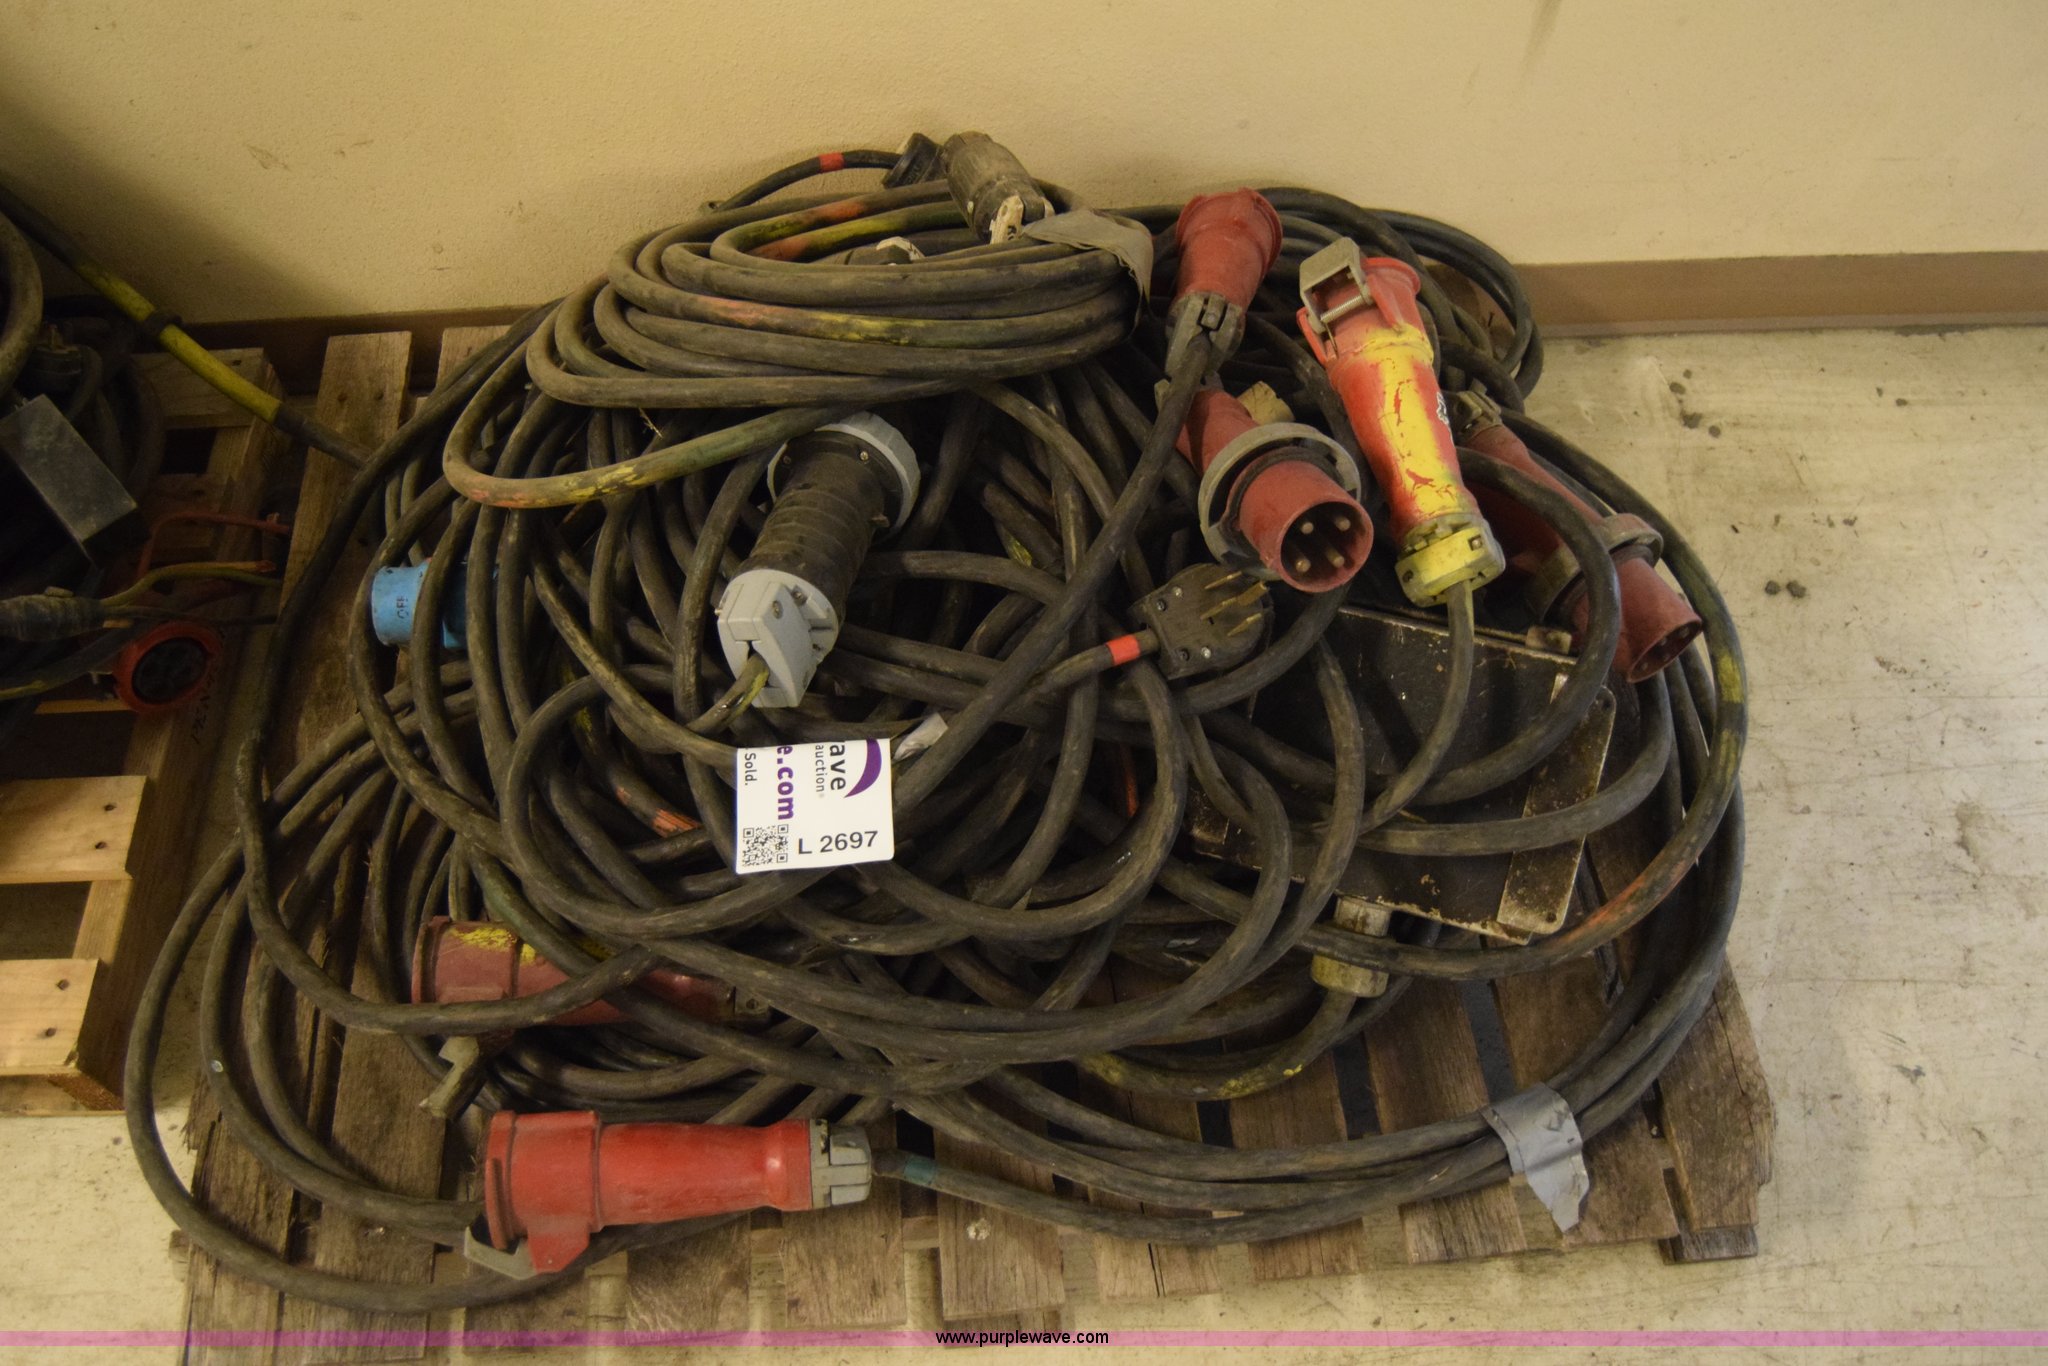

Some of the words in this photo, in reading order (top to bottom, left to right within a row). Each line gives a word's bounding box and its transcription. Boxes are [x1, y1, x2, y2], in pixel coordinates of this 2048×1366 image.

[744, 752, 757, 786] Sold.
[777, 745, 795, 820] e.com
[814, 745, 826, 792] auction
[829, 744, 847, 790] ave
[798, 838, 813, 855] L
[819, 830, 879, 853] 2697
